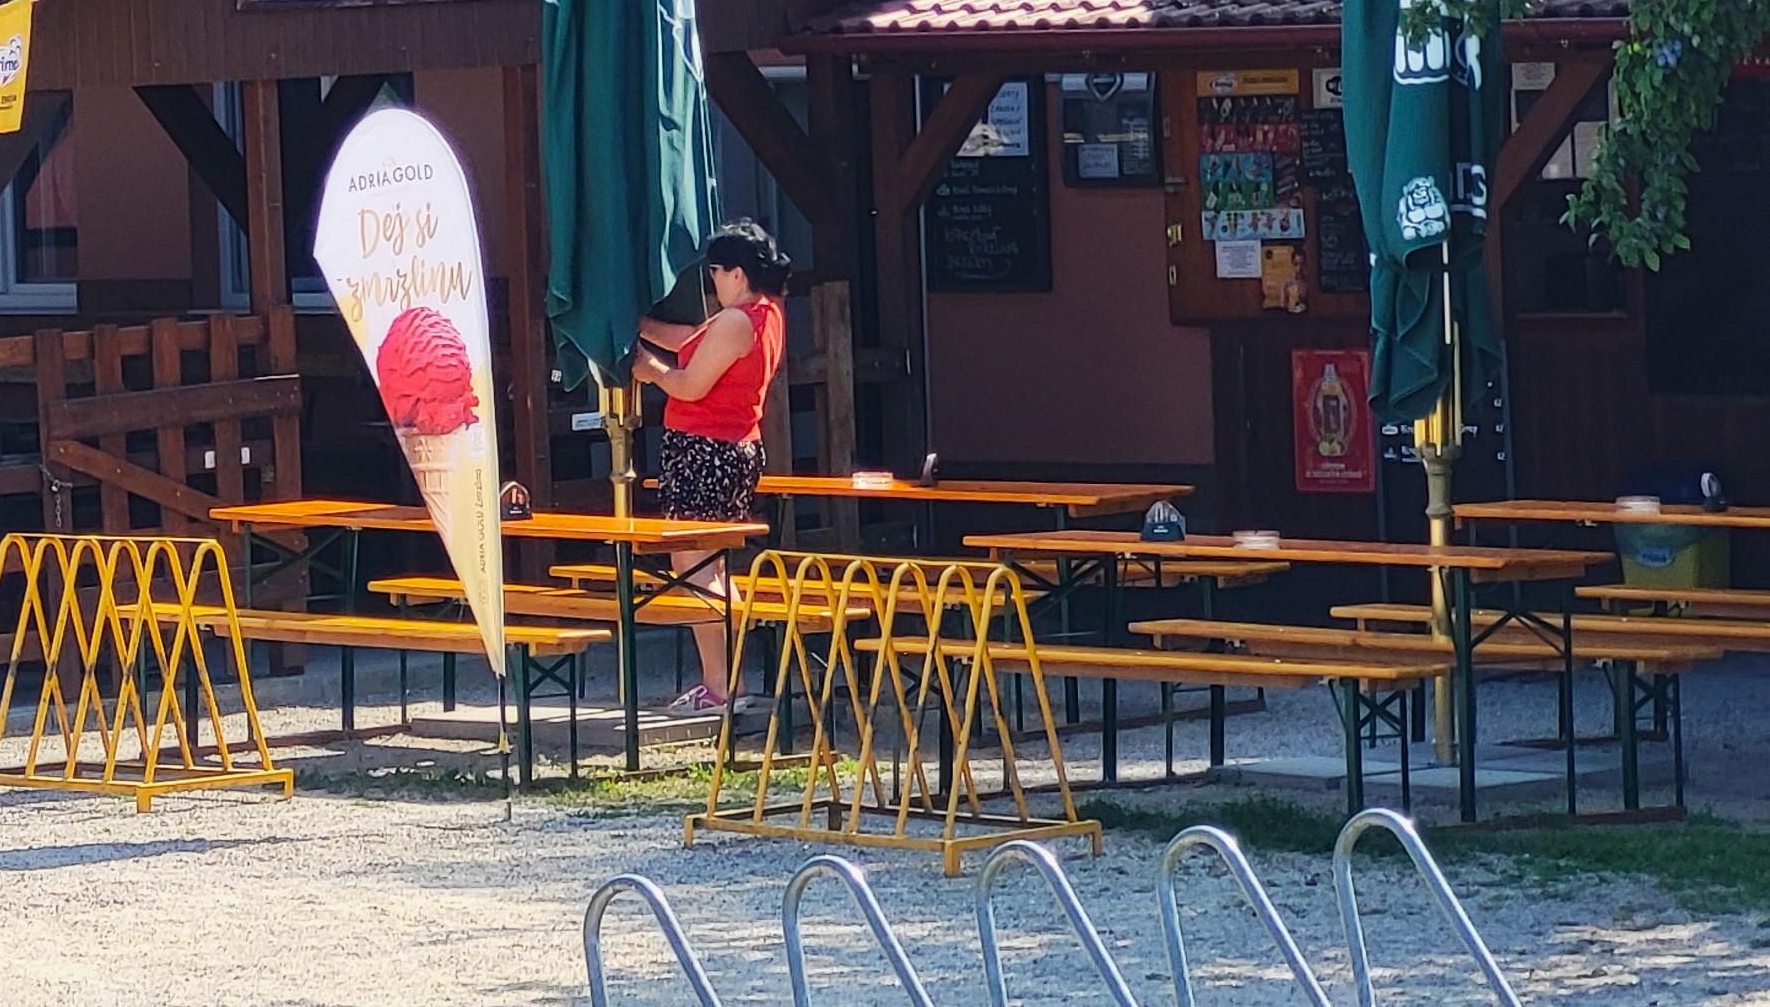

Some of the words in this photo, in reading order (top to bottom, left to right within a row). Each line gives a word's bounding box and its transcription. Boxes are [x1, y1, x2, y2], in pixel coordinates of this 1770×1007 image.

[359, 202, 409, 259] Dej
[416, 202, 439, 248] si
[346, 255, 472, 323] zmrzlinu
